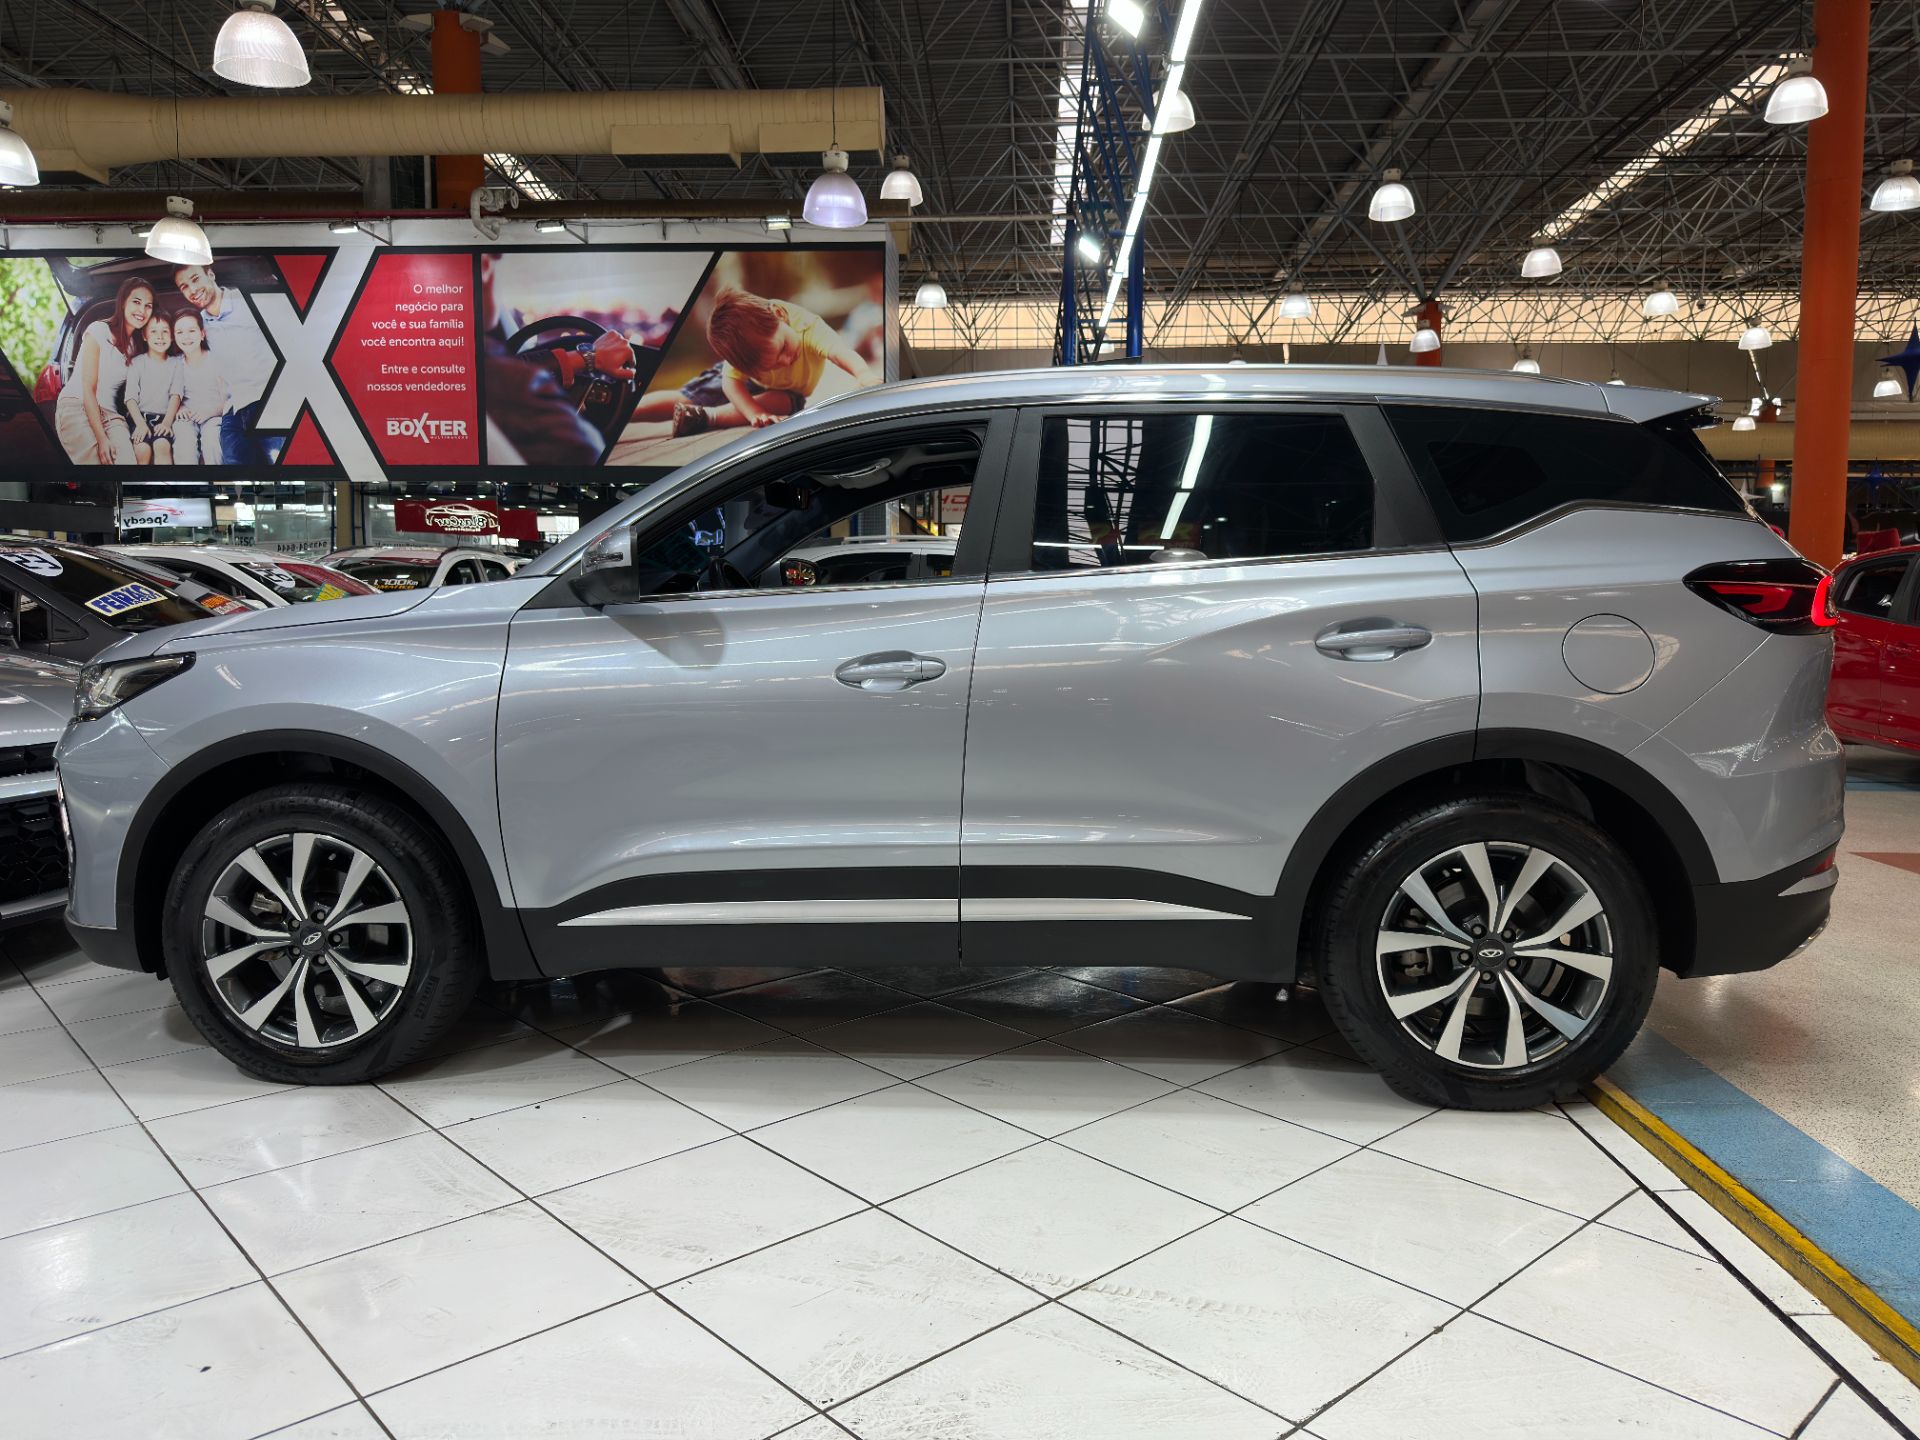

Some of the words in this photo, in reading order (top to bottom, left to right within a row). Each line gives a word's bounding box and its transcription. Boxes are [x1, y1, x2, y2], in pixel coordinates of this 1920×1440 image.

[413, 284, 423, 294] O
[425, 284, 464, 294] melhor
[395, 301, 438, 314] negócio
[440, 303, 464, 314] para
[372, 319, 397, 329] você
[399, 321, 406, 329] e
[409, 321, 427, 329] sua
[429, 318, 464, 329] família
[361, 336, 387, 346] você
[389, 337, 436, 346] encontra
[438, 336, 464, 348] aqui!
[381, 364, 409, 374] Entre
[411, 366, 418, 374] e
[420, 364, 466, 374] consulte
[367, 382, 403, 392] nossos
[405, 381, 467, 392] vendedores
[386, 412, 468, 444] BOXTER
